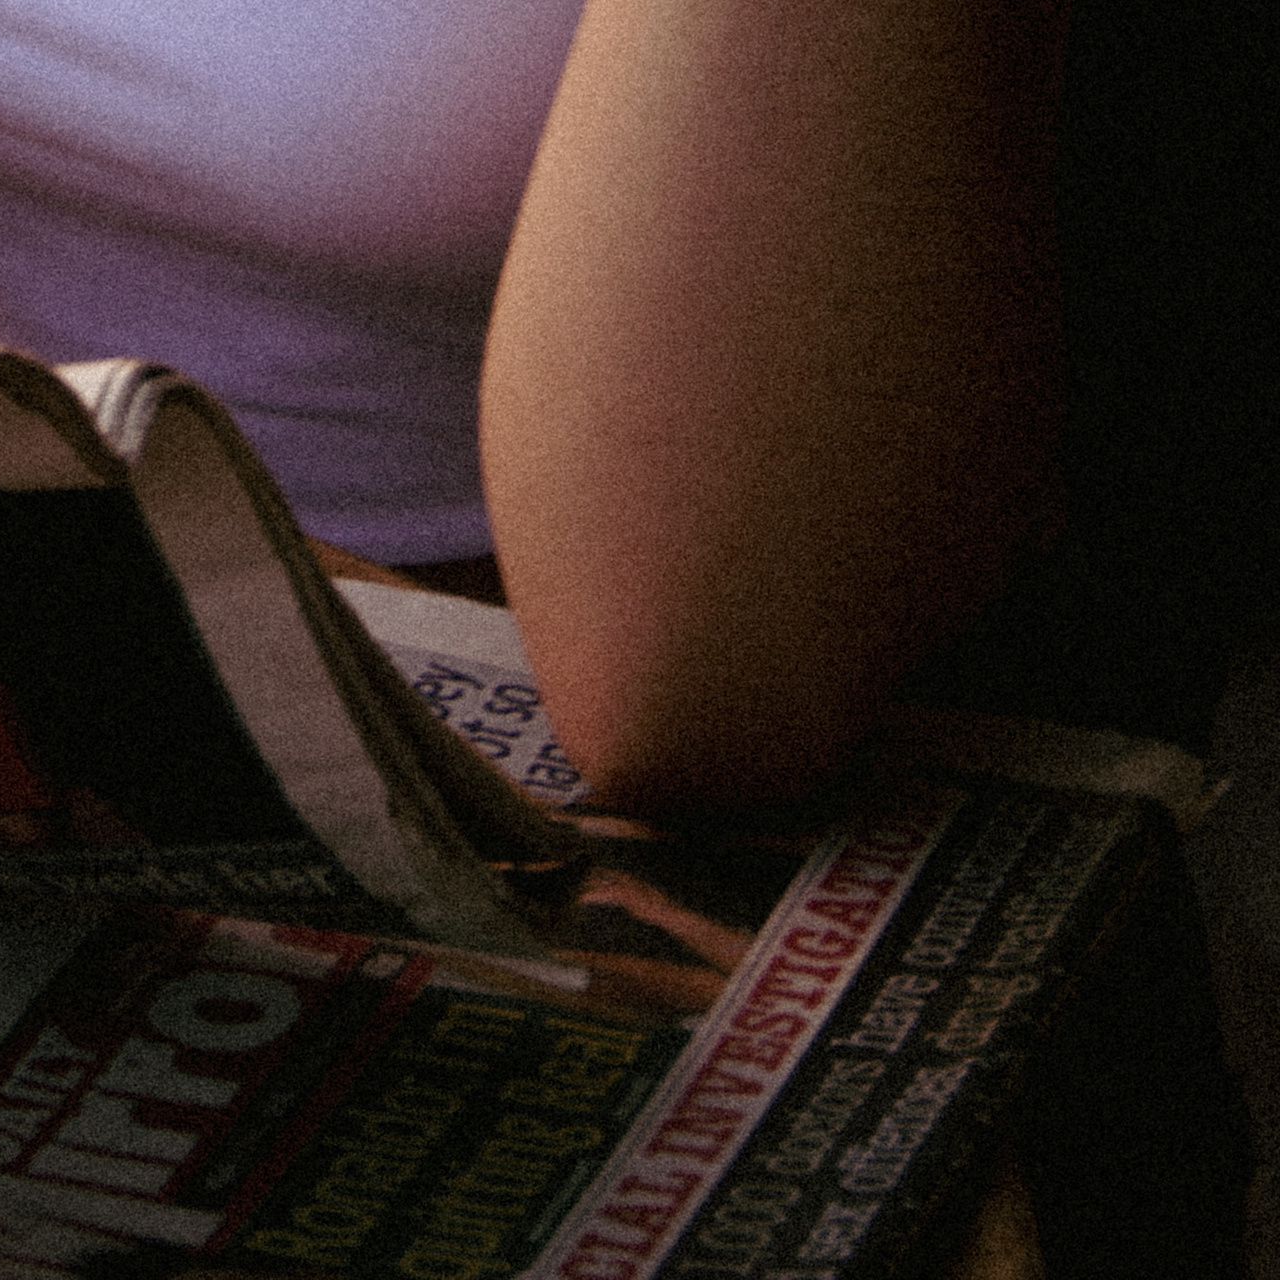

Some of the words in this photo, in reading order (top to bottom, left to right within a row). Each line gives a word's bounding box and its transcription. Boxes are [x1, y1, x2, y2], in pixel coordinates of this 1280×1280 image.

[646, 795, 945, 1164] INVESTIGATIO
[828, 972, 944, 1054] have
[498, 1016, 647, 1112] Real
